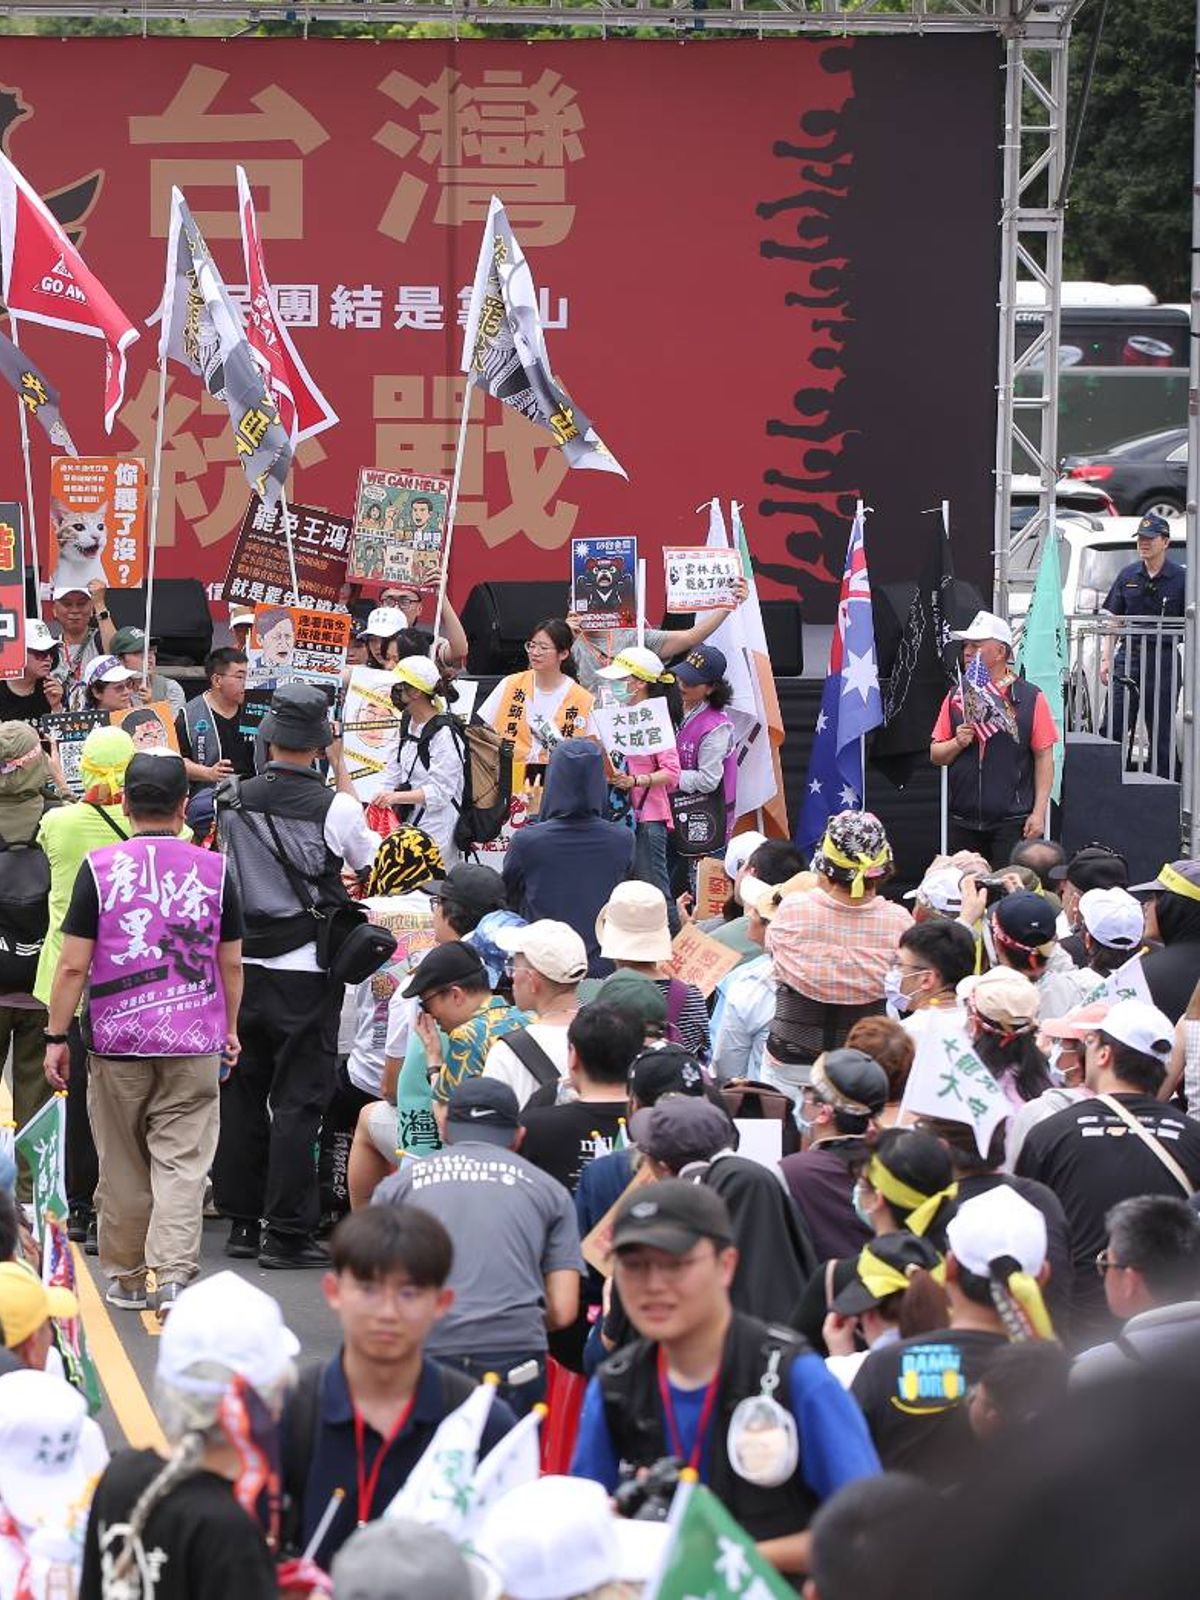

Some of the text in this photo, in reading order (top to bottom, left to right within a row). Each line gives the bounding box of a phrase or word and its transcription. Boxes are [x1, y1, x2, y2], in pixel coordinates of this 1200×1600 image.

[128, 64, 585, 248] 台灣
[40, 276, 64, 293] GO
[144, 283, 568, 331] 團結是山
[366, 471, 447, 493] WE CAN HELP
[111, 463, 138, 585] 你罷了沒?
[251, 503, 353, 555] 罷免王鴻
[104, 844, 218, 922] 剷除
[400, 1108, 443, 1150] 灣
